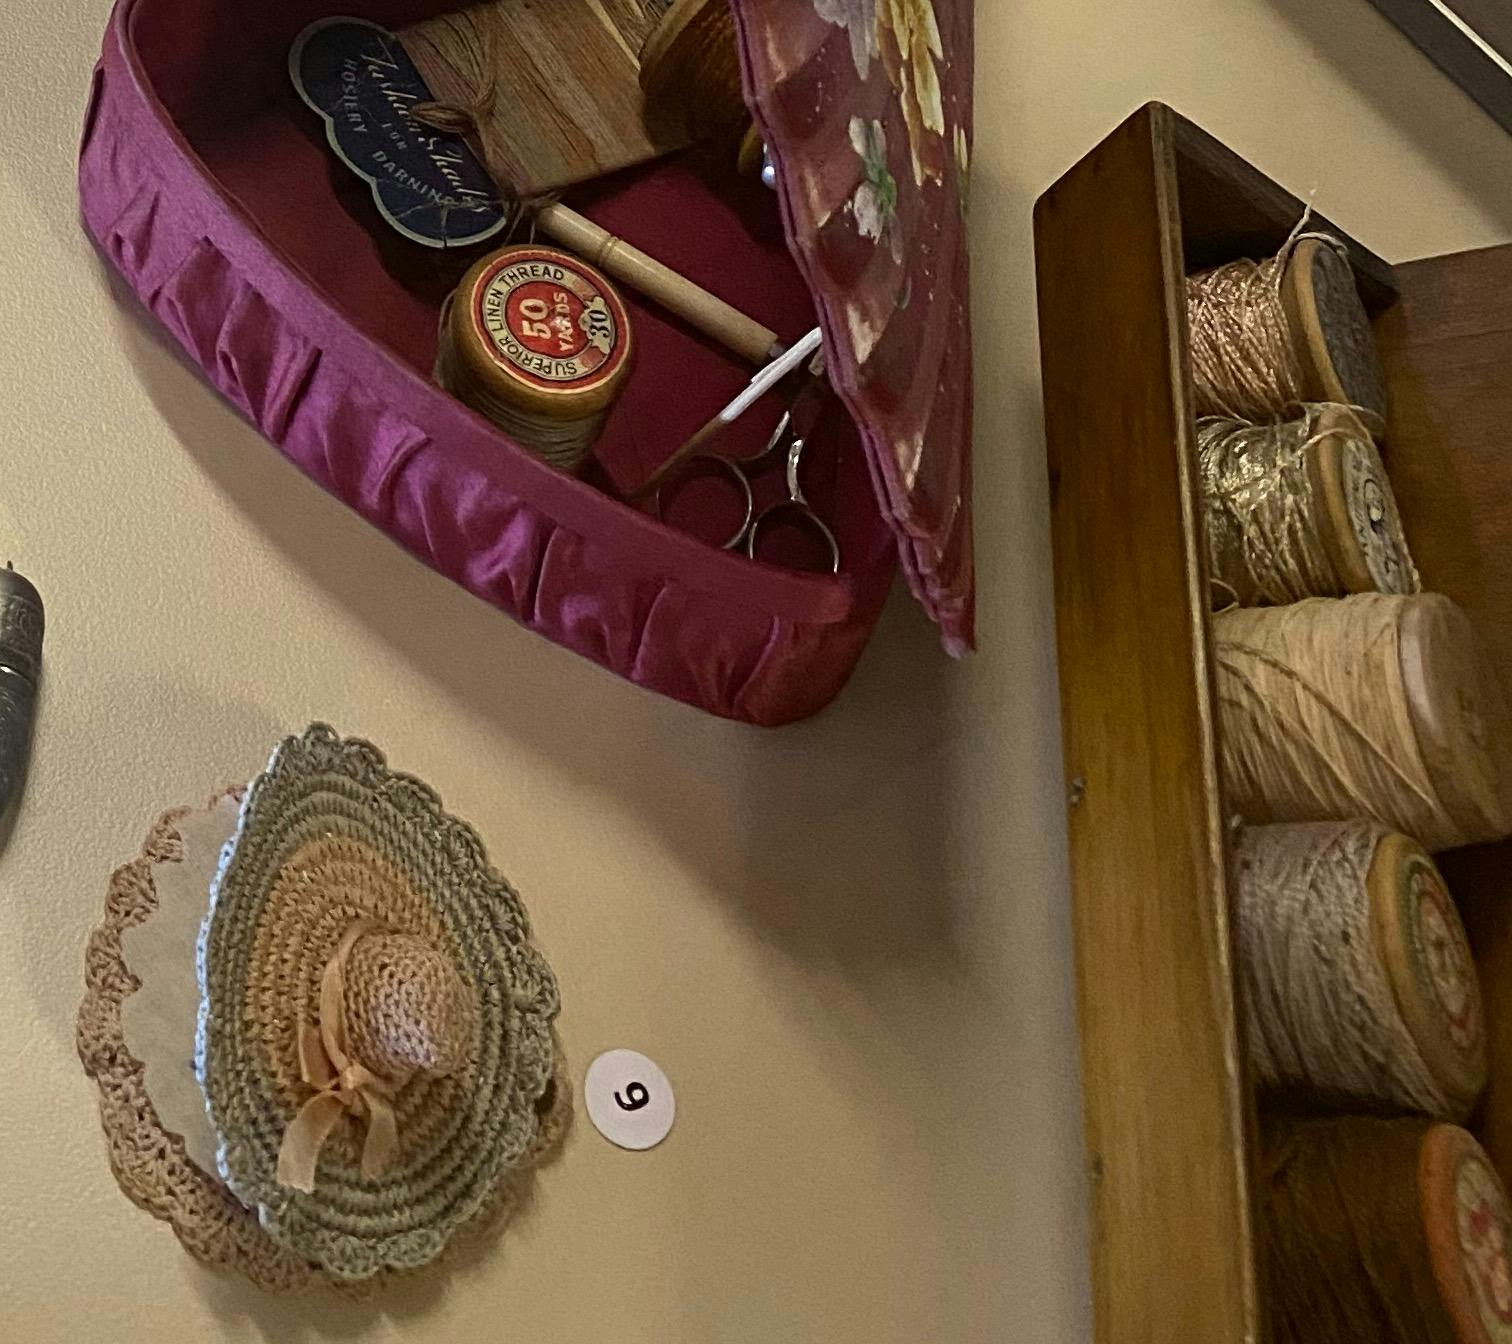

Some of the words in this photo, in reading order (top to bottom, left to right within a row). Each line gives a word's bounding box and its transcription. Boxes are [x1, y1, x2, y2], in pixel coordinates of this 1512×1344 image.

[499, 265, 565, 288] THREAD
[488, 288, 504, 333] LINEN
[519, 298, 552, 339] 50
[553, 291, 574, 351] YARDS
[589, 309, 610, 338] 30
[499, 336, 578, 376] SUPERIOR
